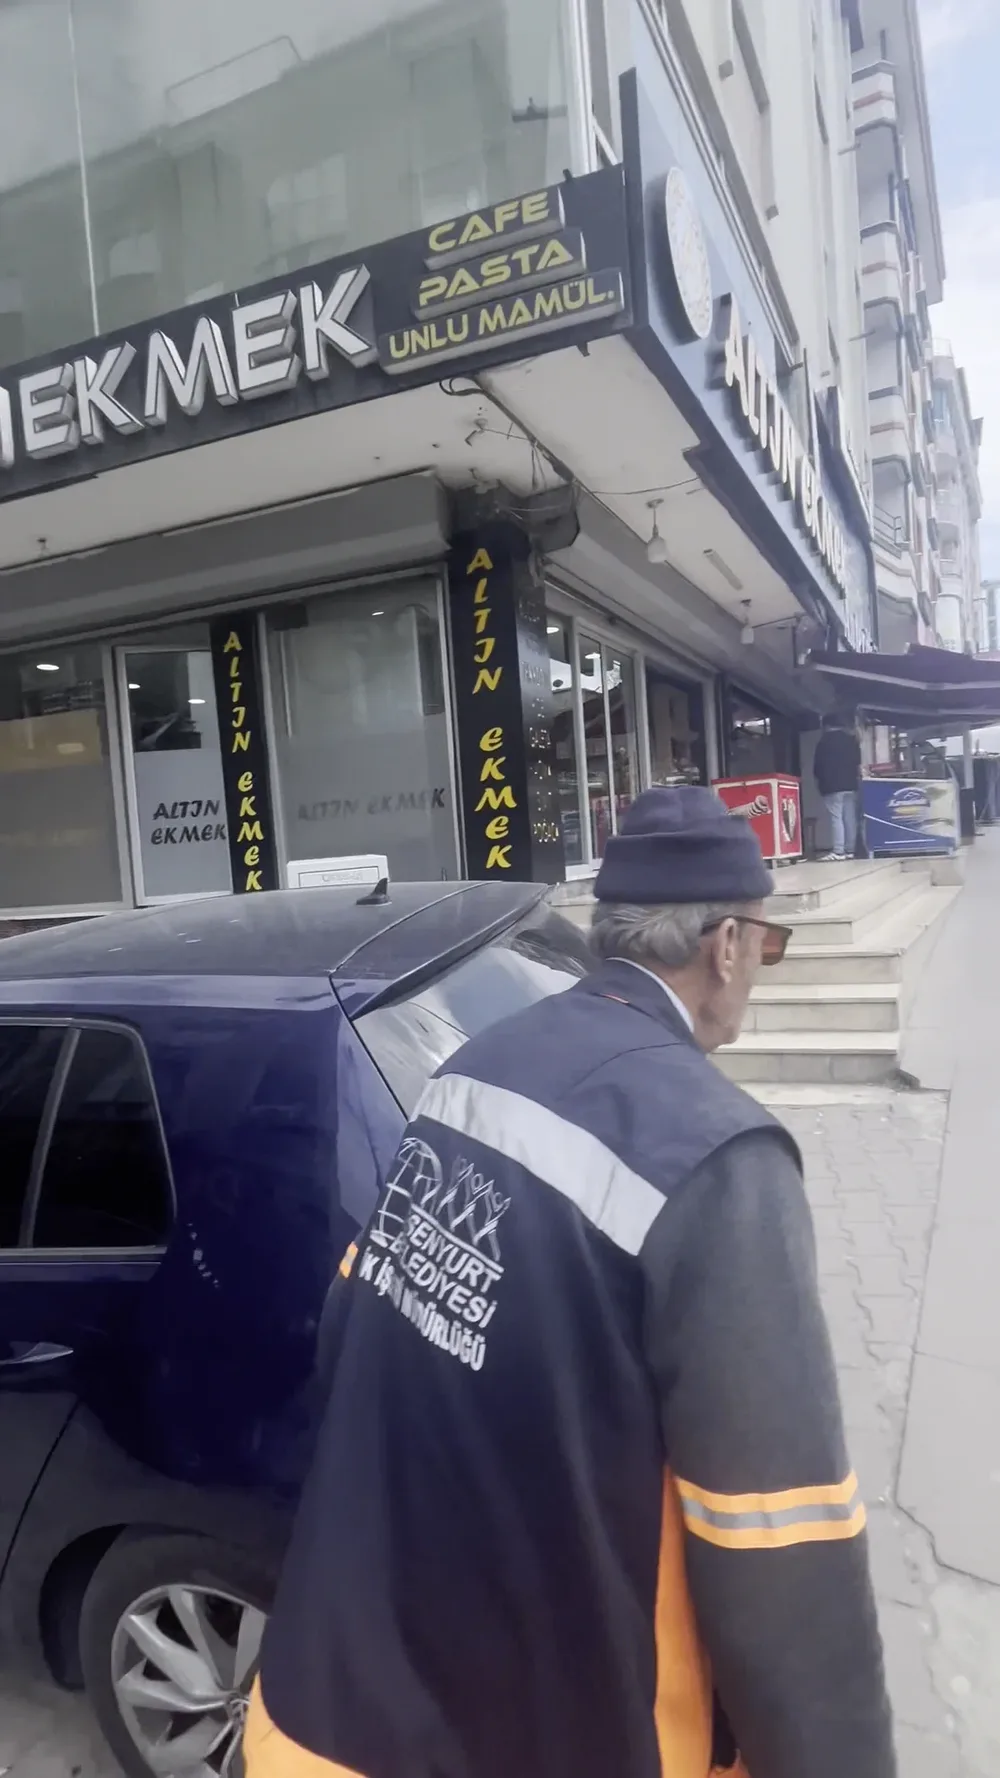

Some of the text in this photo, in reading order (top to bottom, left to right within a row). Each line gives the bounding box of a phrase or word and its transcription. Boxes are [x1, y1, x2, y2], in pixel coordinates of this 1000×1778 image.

[429, 191, 549, 252] CAFE
[419, 238, 574, 307] PASTA
[389, 277, 615, 359] UNLU MAMÜL.
[18, 263, 379, 460] EKMEK
[150, 823, 228, 846] EKMEK
[388, 1231, 499, 1329] BLEDİYESİ
